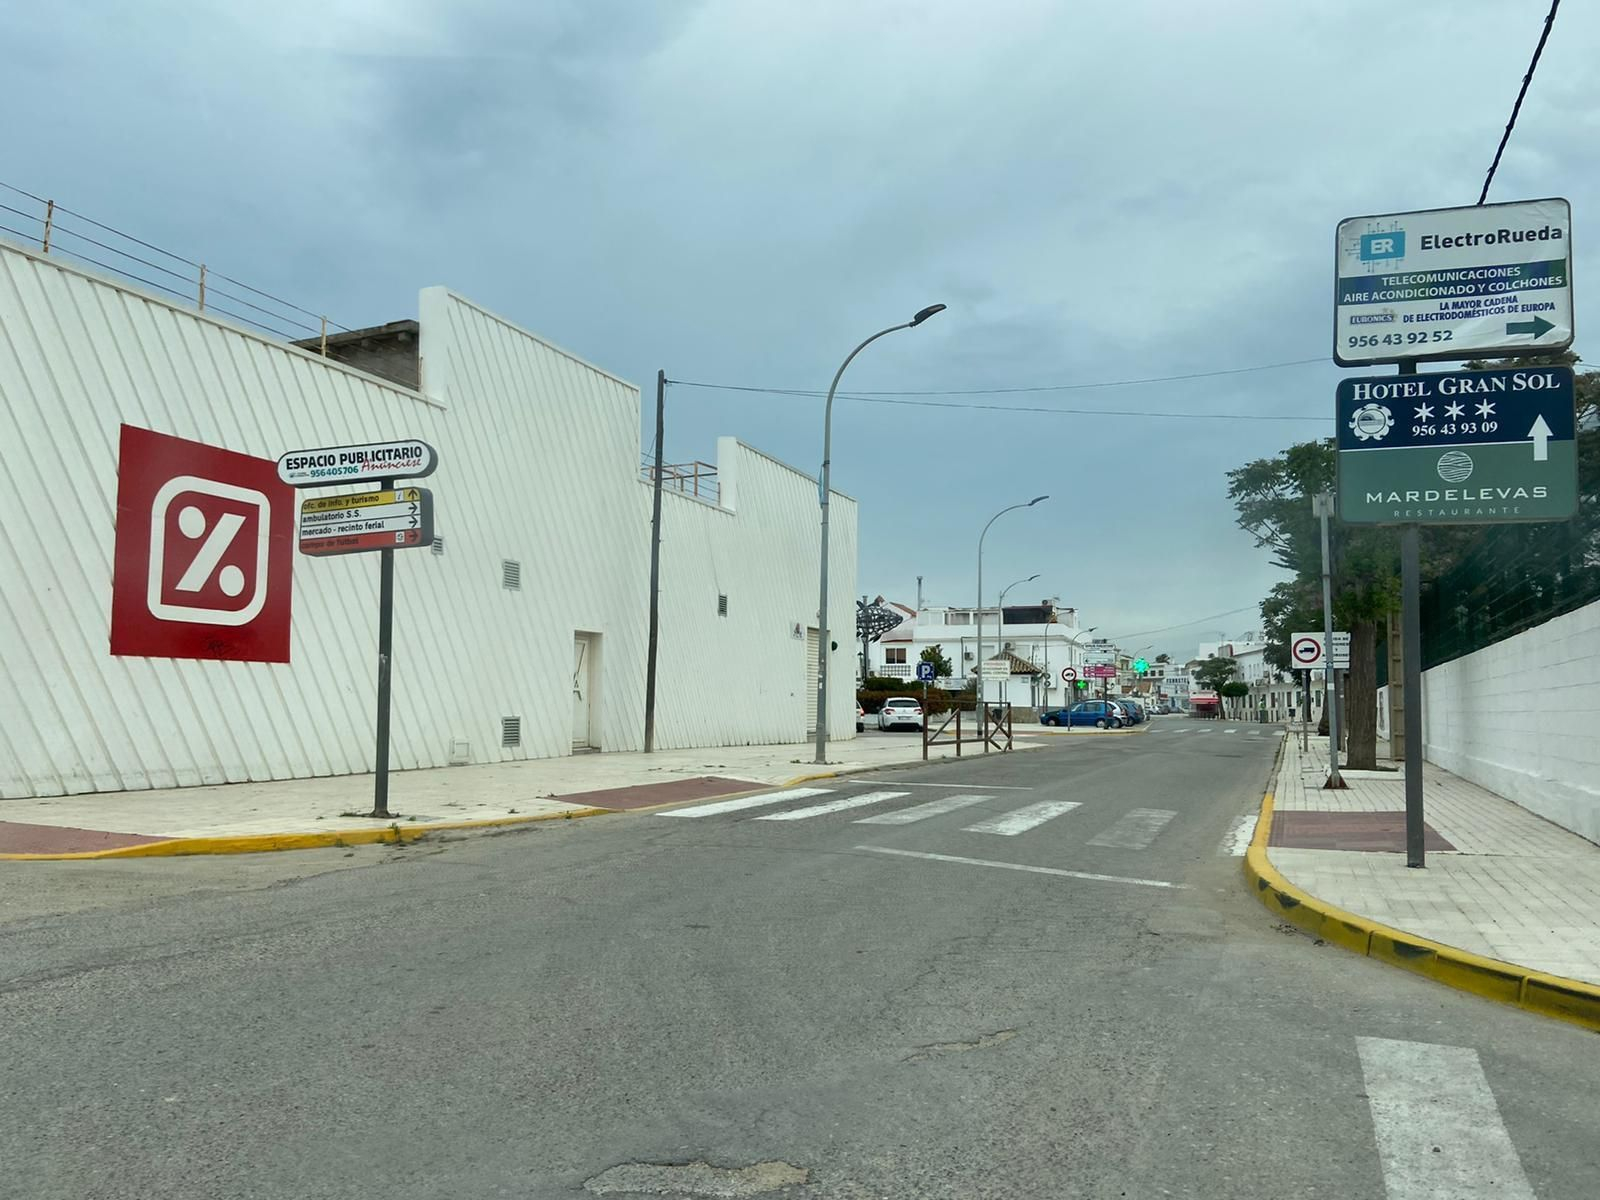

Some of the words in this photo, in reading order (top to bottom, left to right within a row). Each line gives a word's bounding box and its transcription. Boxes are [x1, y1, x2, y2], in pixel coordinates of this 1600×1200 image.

[1370, 238, 1394, 255] ER
[1420, 225, 1563, 251] ElectroRueda
[1381, 266, 1521, 286] TELECOMUNICACIONES
[1343, 291, 1370, 303] AIRE
[1371, 284, 1476, 301] ACONDICIONADO
[1477, 283, 1486, 293] Y
[1487, 275, 1563, 292] COLCHONES
[1403, 314, 1414, 323] DE
[1416, 306, 1506, 323] ELECTRODOMÉSTICOS
[1508, 304, 1519, 313] DE
[1521, 301, 1556, 314] EUROPA
[1439, 301, 1450, 312] LA
[1451, 299, 1482, 311] MAYOR
[1484, 295, 1518, 308] CADENA
[1351, 315, 1394, 324] EURONICS
[1348, 334, 1379, 348] 956
[1382, 332, 1403, 346] 43
[1407, 331, 1429, 344] 92
[1432, 330, 1454, 343] 52
[1352, 381, 1432, 401] HOTEL
[1438, 376, 1507, 396] GRAN
[1512, 372, 1561, 391] SOL
[1412, 424, 1437, 437] 956
[1440, 423, 1457, 436] 43
[1460, 422, 1478, 435] 93
[1481, 421, 1499, 433] 09
[286, 454, 337, 470] ESPACIO
[339, 446, 423, 466] PUBLICITARIO
[310, 465, 359, 478] 956405706
[317, 500, 327, 509] de
[344, 498, 350, 507] y
[351, 494, 380, 505] turismo
[1366, 485, 1548, 504] MARDELEVAS
[302, 511, 345, 523] ambulatorio
[345, 509, 362, 519] S.S.
[1394, 506, 1521, 518] RESTAURANTE
[301, 525, 332, 536] mercado
[337, 522, 364, 533] recinto
[364, 520, 385, 531] ferial
